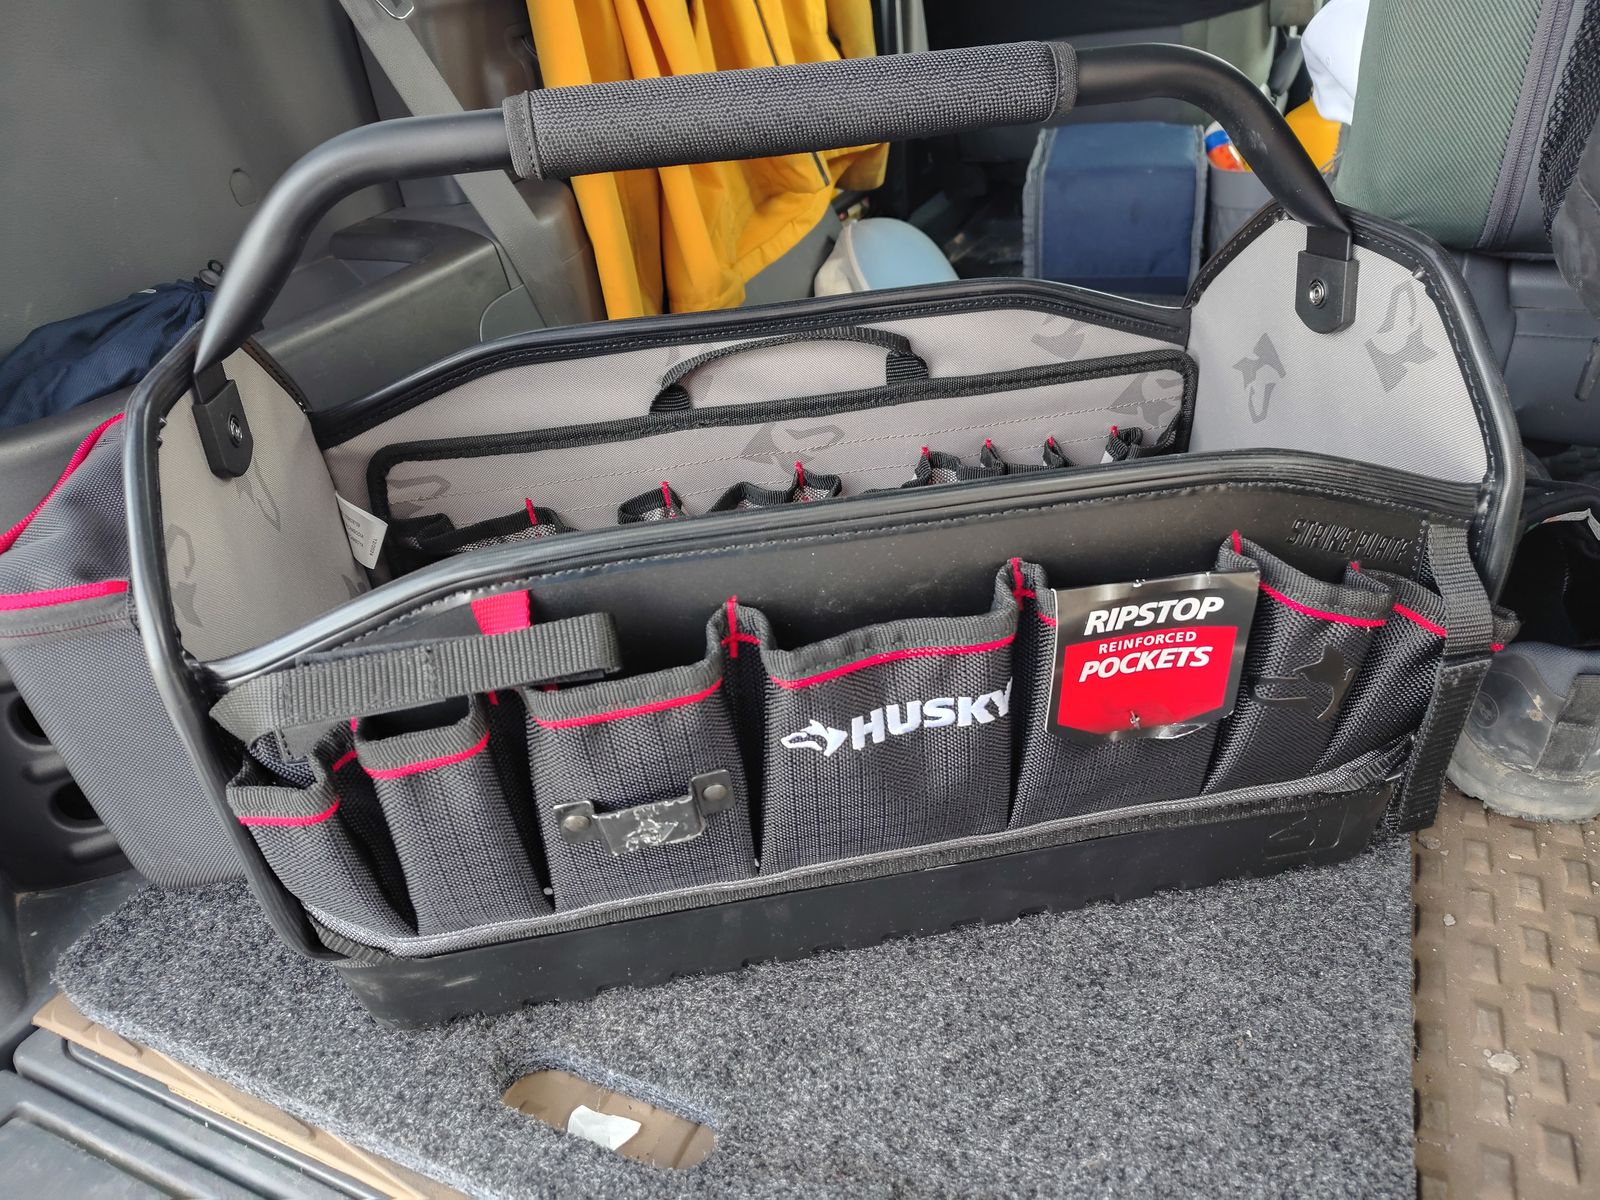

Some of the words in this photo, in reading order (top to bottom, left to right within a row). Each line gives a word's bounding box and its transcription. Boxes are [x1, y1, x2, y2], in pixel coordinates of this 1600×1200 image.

[1286, 519, 1357, 554] STRIKE
[1351, 530, 1413, 561] PLATE
[1083, 596, 1224, 636] RIPSTOP
[1098, 631, 1197, 655] REINFORCED
[1078, 646, 1213, 683] POCKETS
[851, 676, 1013, 751] HUSKY
